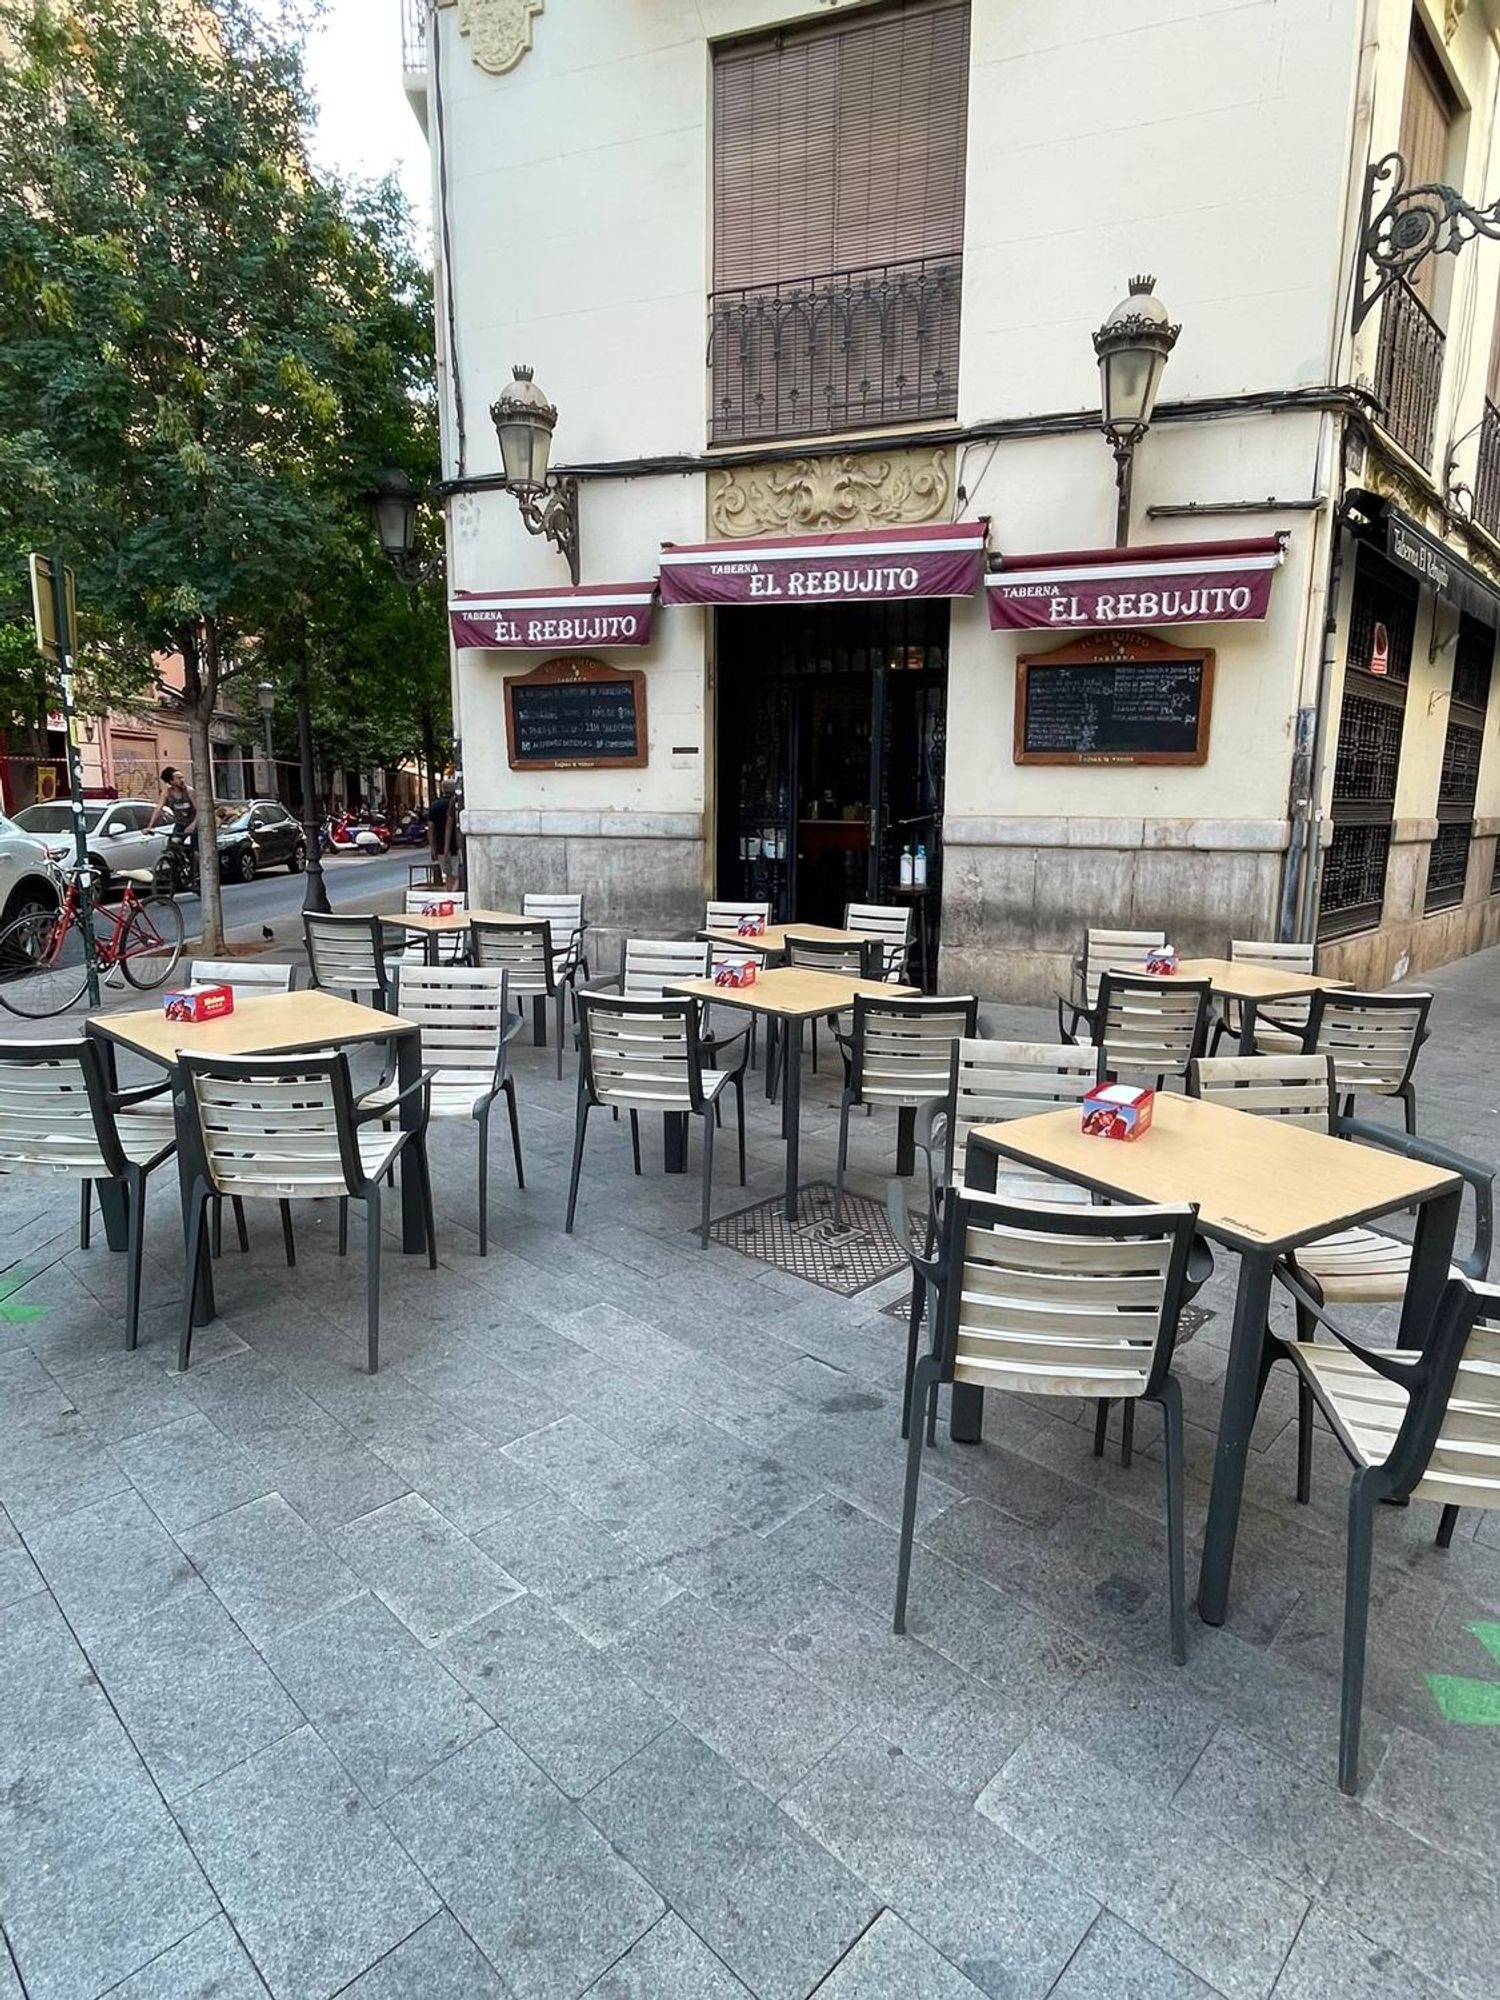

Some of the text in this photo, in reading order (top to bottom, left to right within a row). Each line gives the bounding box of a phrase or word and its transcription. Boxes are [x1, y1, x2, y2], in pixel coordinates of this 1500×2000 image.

[1393, 528, 1419, 568] Taberna
[711, 563, 759, 575] TABERNA
[749, 567, 919, 596] EL REBUJITO
[1002, 585, 1060, 598] TABERNA
[1049, 586, 1253, 622] EL REBUJITO
[462, 611, 503, 621] TABERNA
[495, 615, 637, 642] EL REBUJITO
